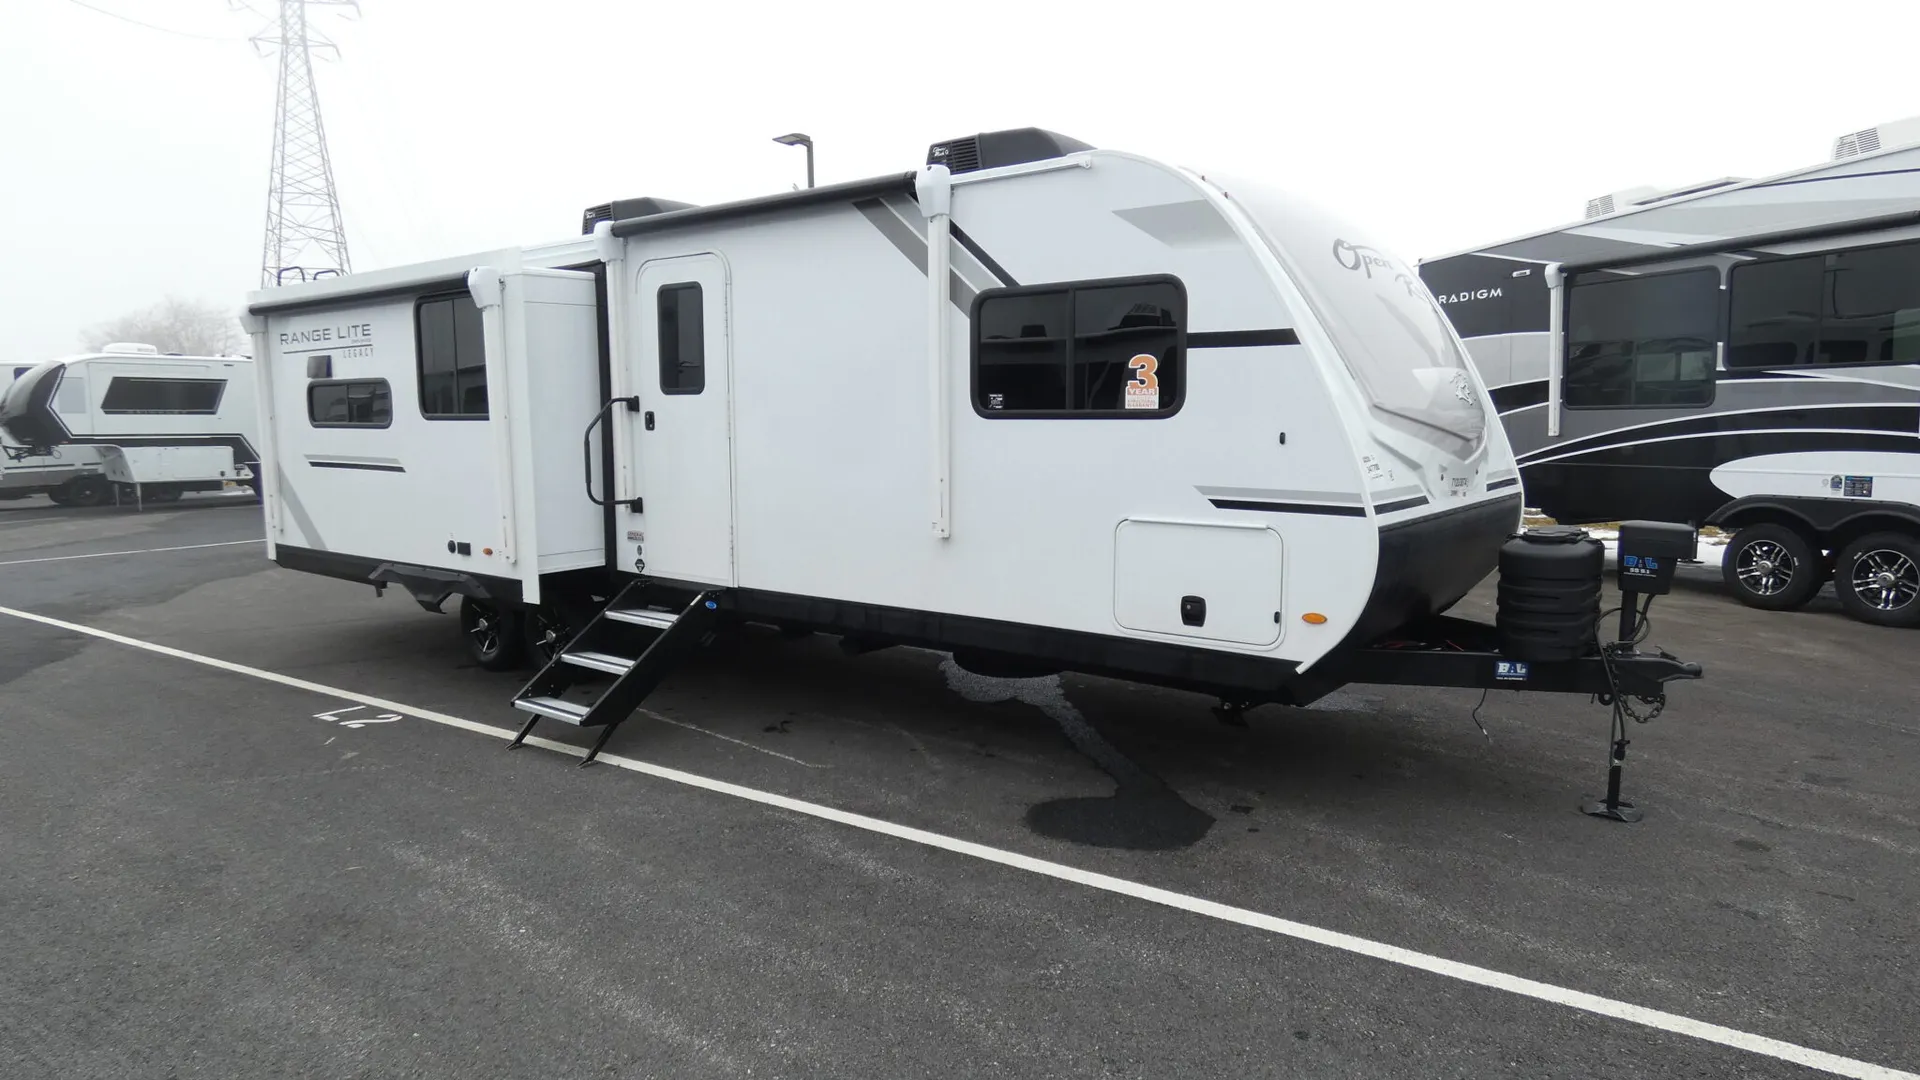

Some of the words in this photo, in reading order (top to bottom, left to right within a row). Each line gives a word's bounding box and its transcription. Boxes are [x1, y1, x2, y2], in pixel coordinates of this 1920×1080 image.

[1333, 238, 1394, 279] Open
[1438, 287, 1502, 304] RADIGM
[280, 328, 331, 345] RANGE
[337, 323, 371, 339] LITE
[343, 347, 374, 359] LEGACY
[1128, 353, 1158, 388] 3
[1129, 388, 1156, 396] YEAR
